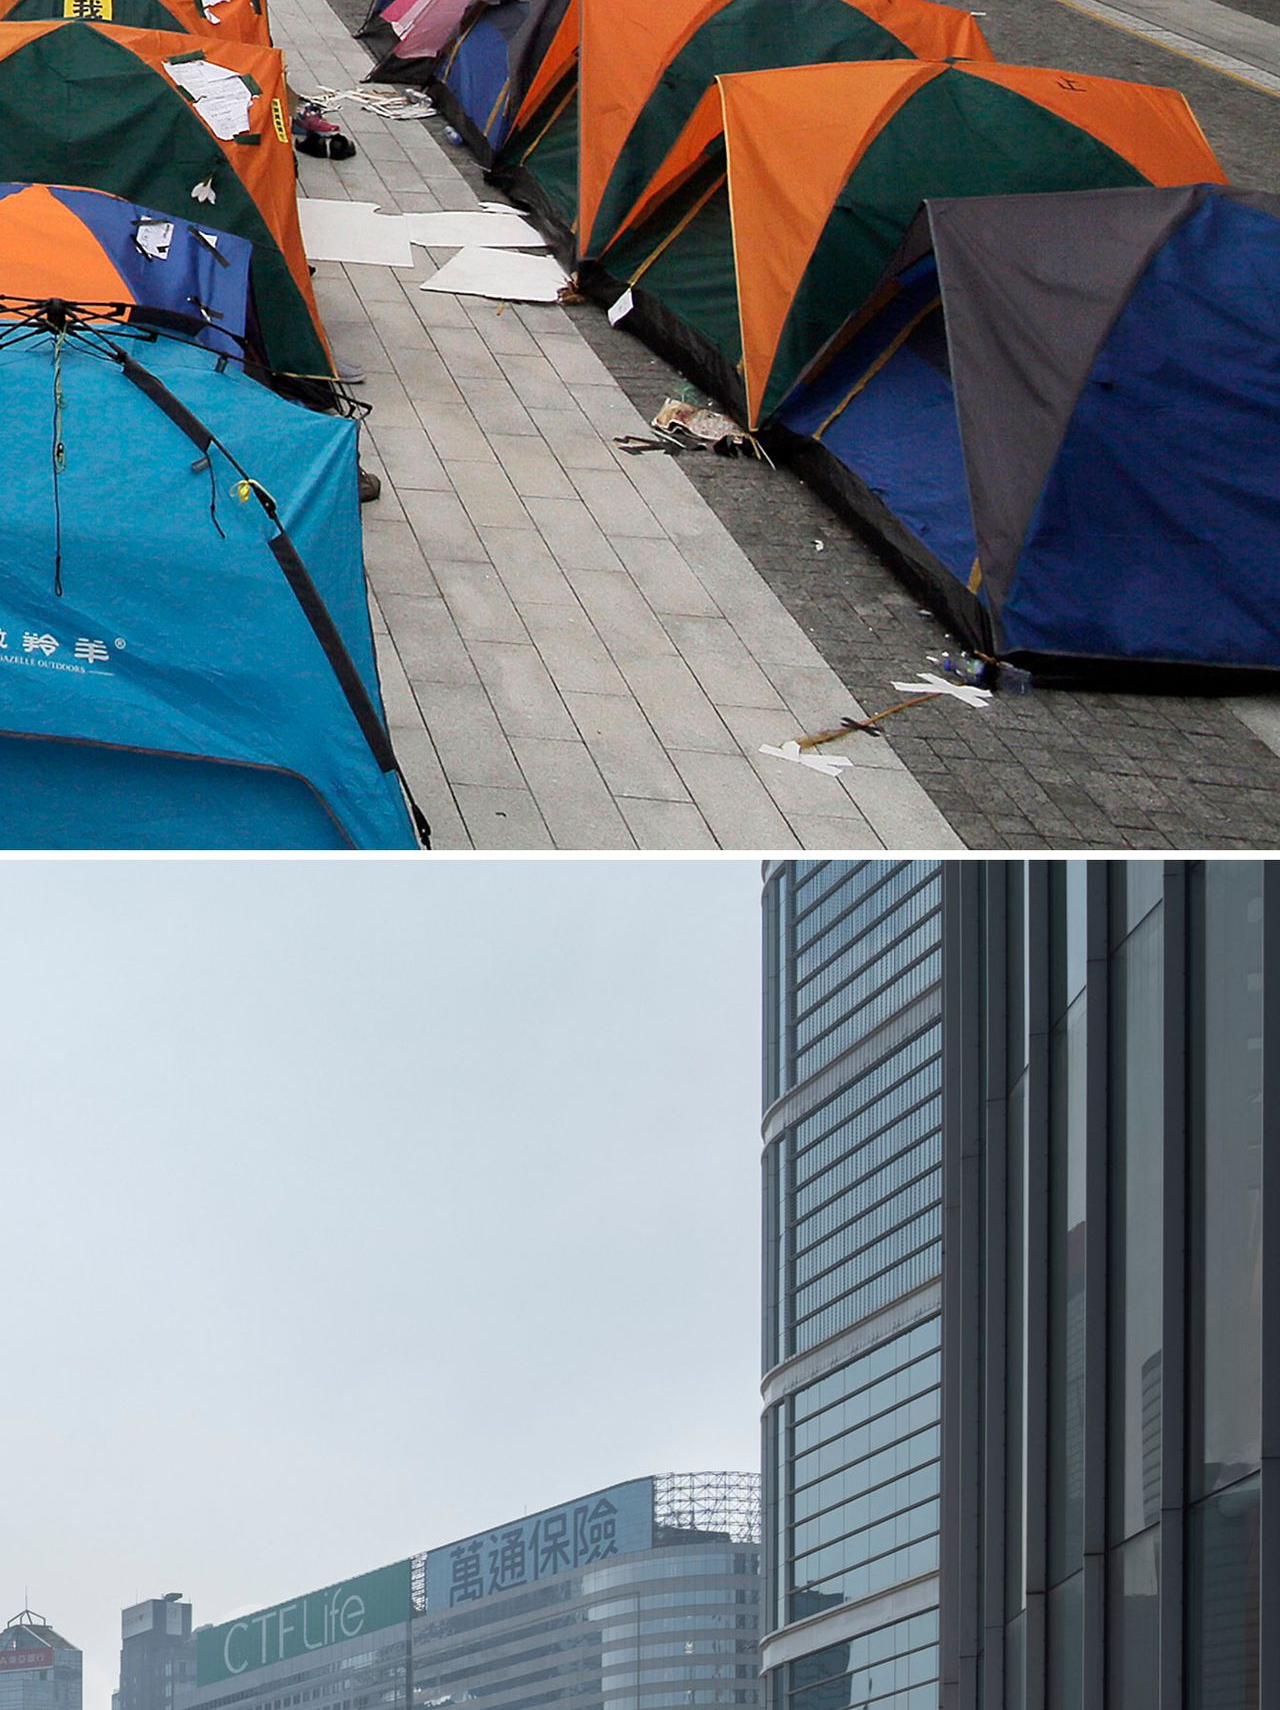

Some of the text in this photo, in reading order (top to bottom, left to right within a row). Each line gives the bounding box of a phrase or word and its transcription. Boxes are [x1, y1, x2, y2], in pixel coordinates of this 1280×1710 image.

[73, 0, 103, 19] 我
[37, 659, 87, 675] OUTDOORS
[449, 1497, 618, 1604] 萬通保險
